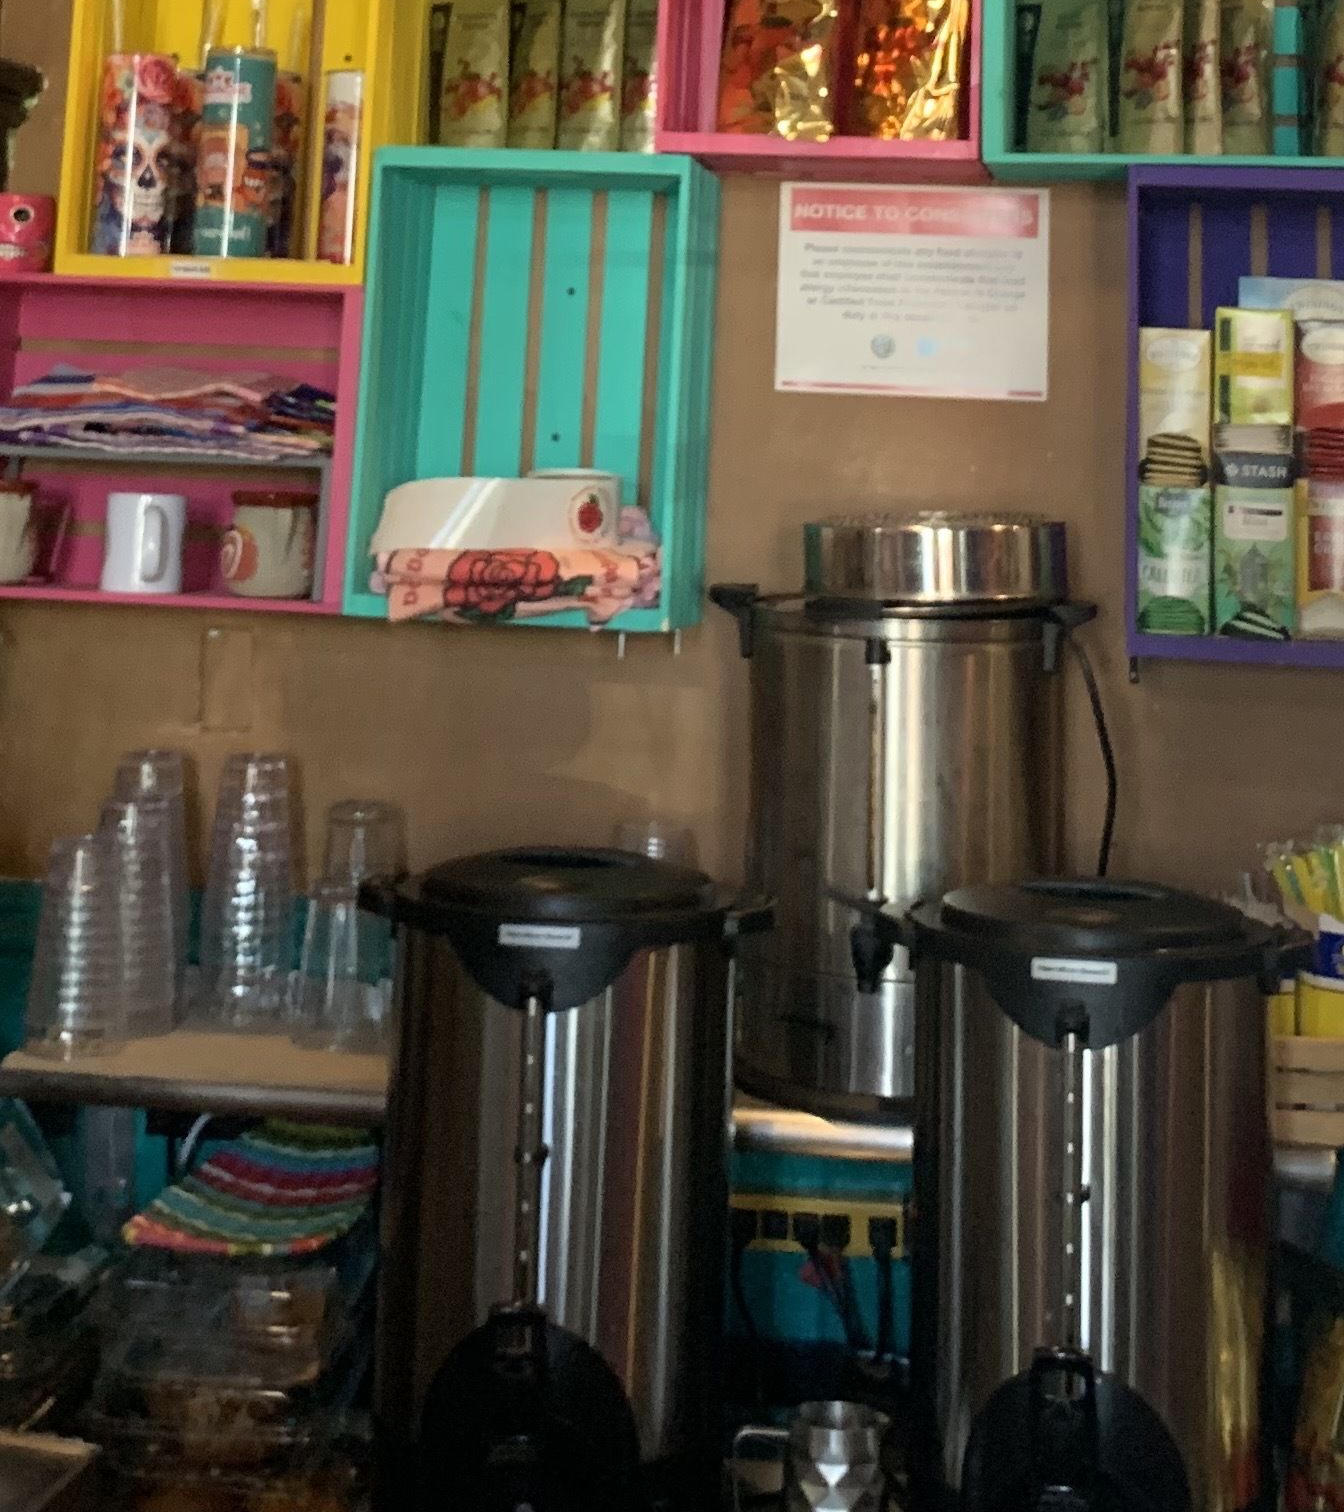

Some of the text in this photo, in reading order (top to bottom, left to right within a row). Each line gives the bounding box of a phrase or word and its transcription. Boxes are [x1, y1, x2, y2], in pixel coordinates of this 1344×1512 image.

[794, 202, 867, 220] NOTICE
[872, 204, 900, 221] TO
[1240, 463, 1288, 479] STASH
